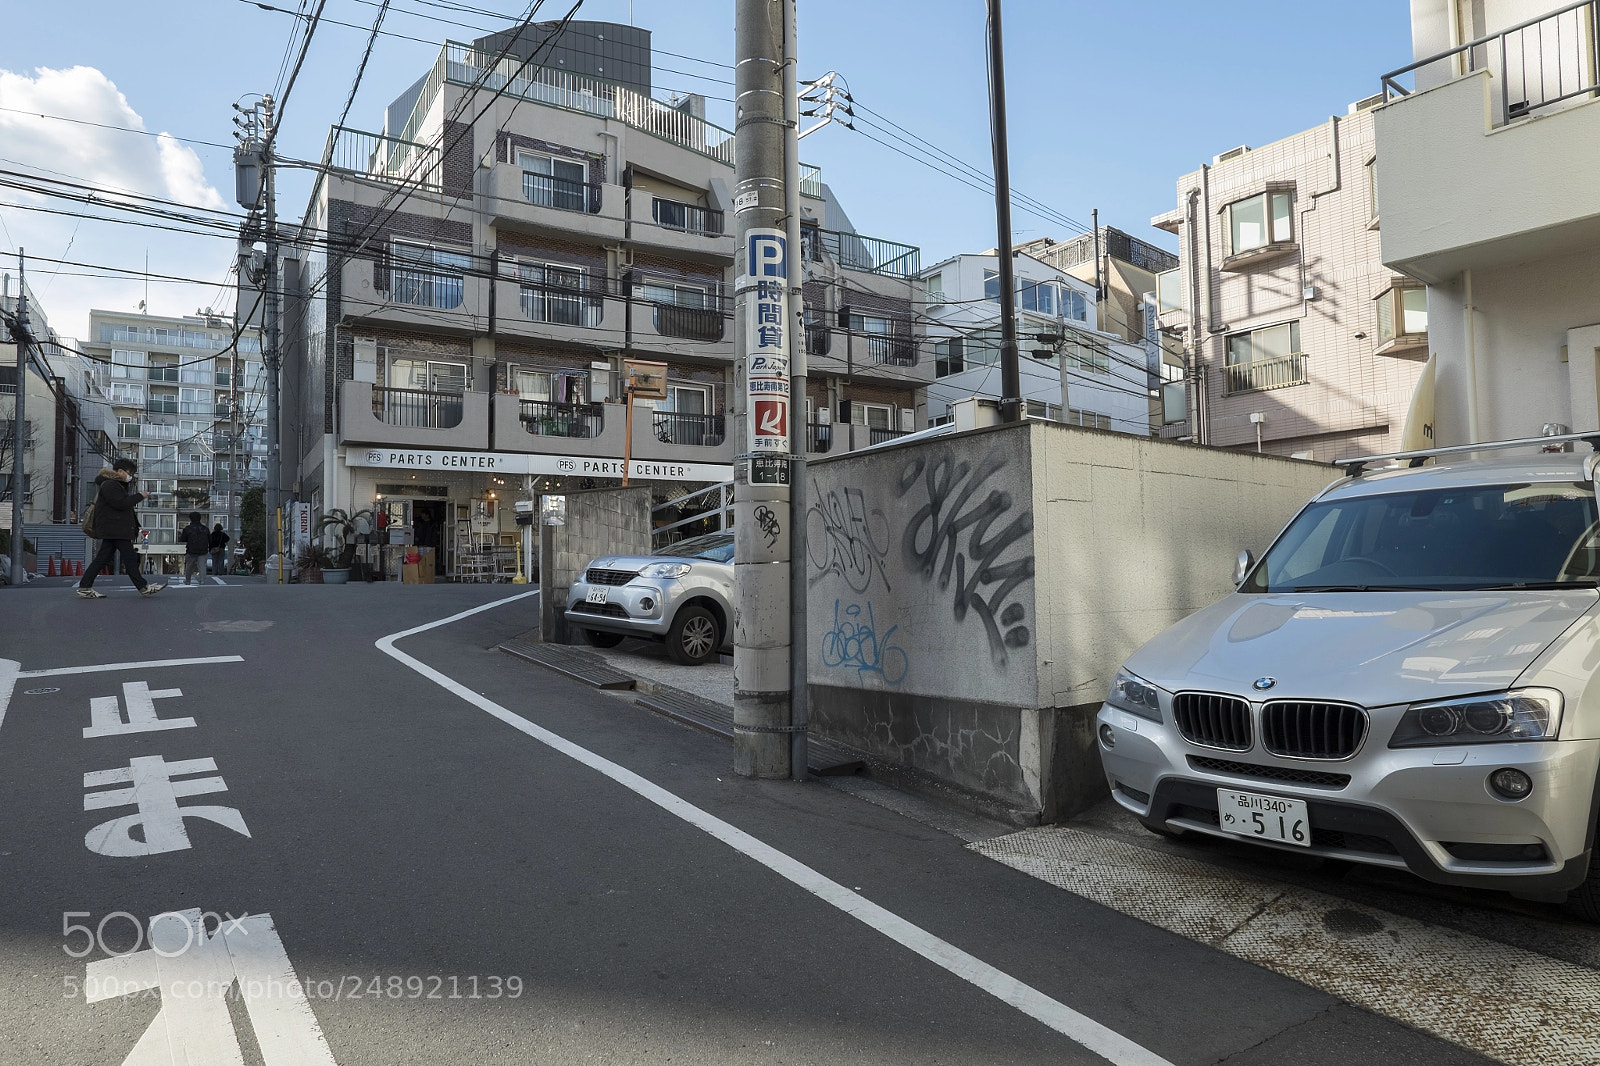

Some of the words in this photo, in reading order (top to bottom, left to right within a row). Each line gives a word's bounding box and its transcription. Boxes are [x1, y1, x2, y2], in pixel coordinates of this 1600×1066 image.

[756, 240, 783, 276] P
[758, 280, 783, 349] 時間貸
[751, 357, 767, 370] Park
[368, 452, 381, 462] PFS
[389, 453, 432, 465] PARTS
[442, 455, 495, 468] CENTER
[559, 460, 574, 470] PFS
[583, 461, 626, 474] PARTS
[636, 464, 684, 477] CENTER
[759, 472, 786, 481] 1-18
[1238, 795, 1286, 813] 品川340
